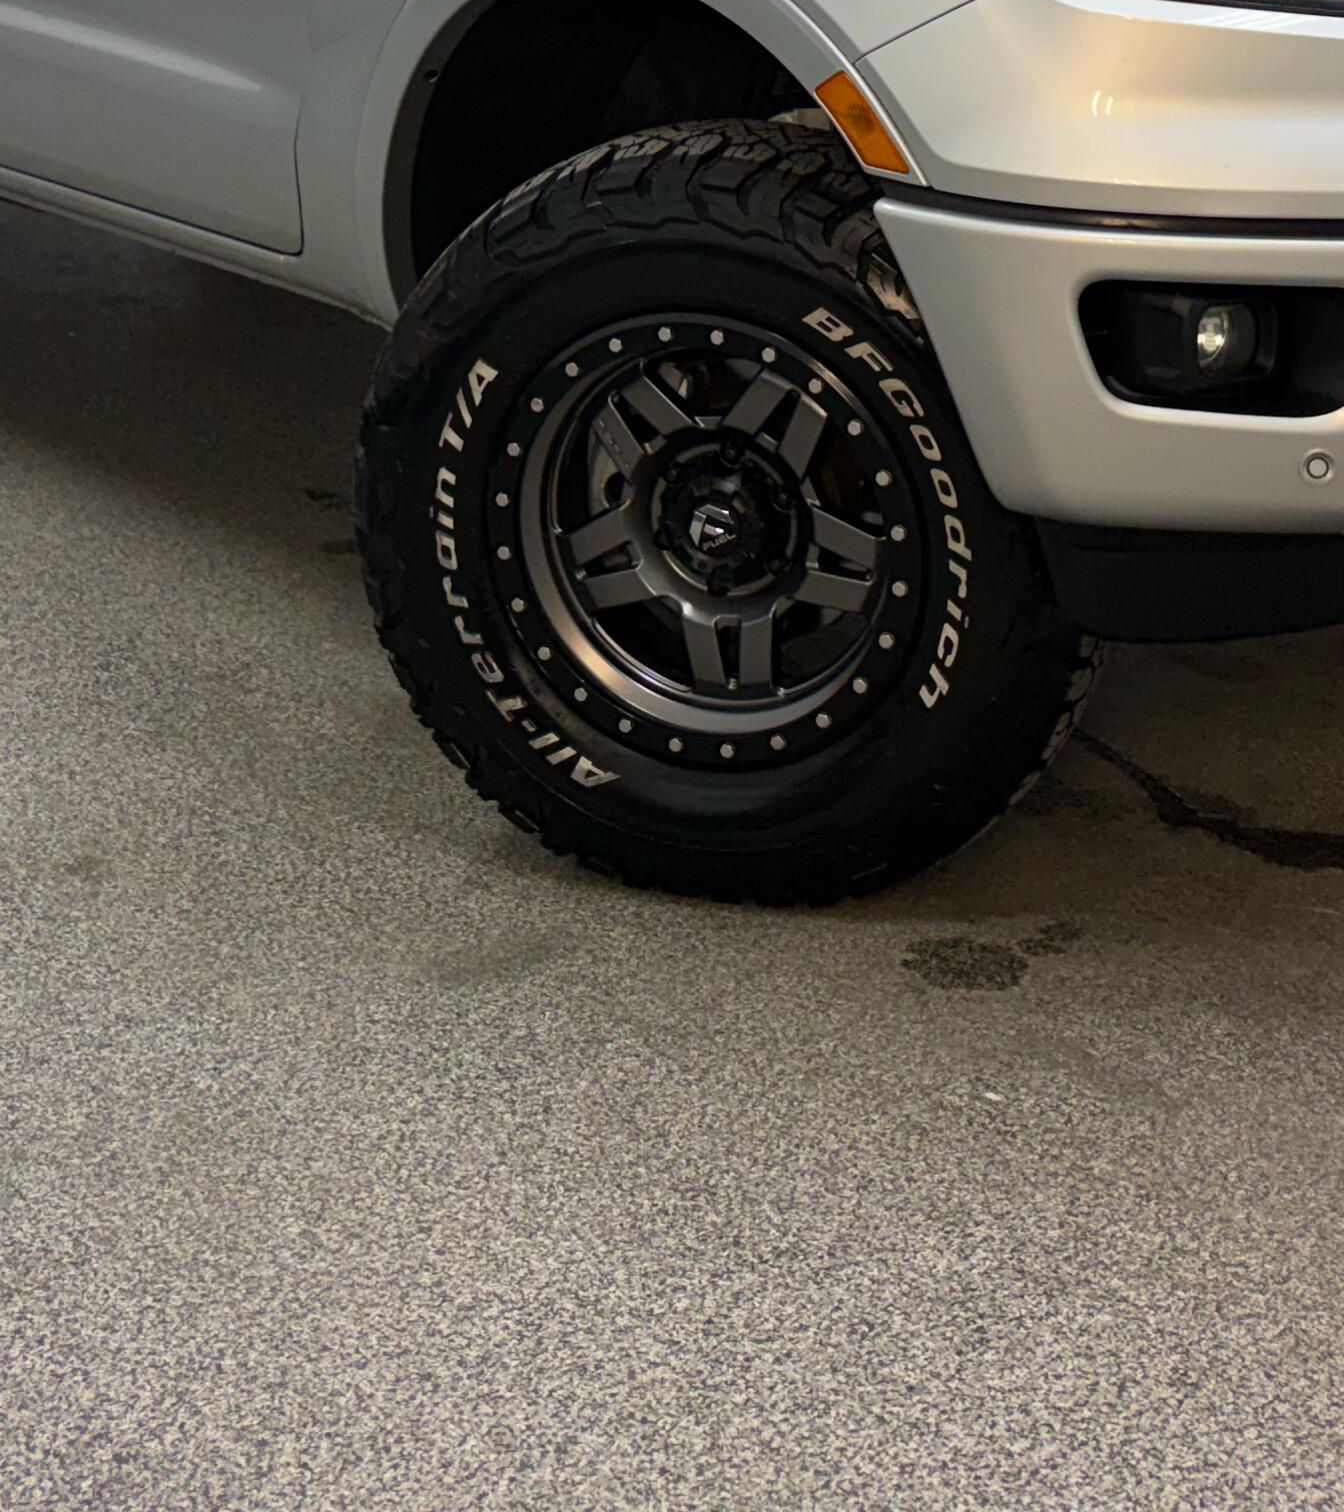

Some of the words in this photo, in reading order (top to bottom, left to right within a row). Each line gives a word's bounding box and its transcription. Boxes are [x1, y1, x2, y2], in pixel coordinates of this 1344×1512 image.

[437, 357, 499, 453] T/A
[801, 306, 974, 710] BFGoodrich
[428, 466, 622, 789] All-Terrain
[700, 531, 738, 553] FUEL
